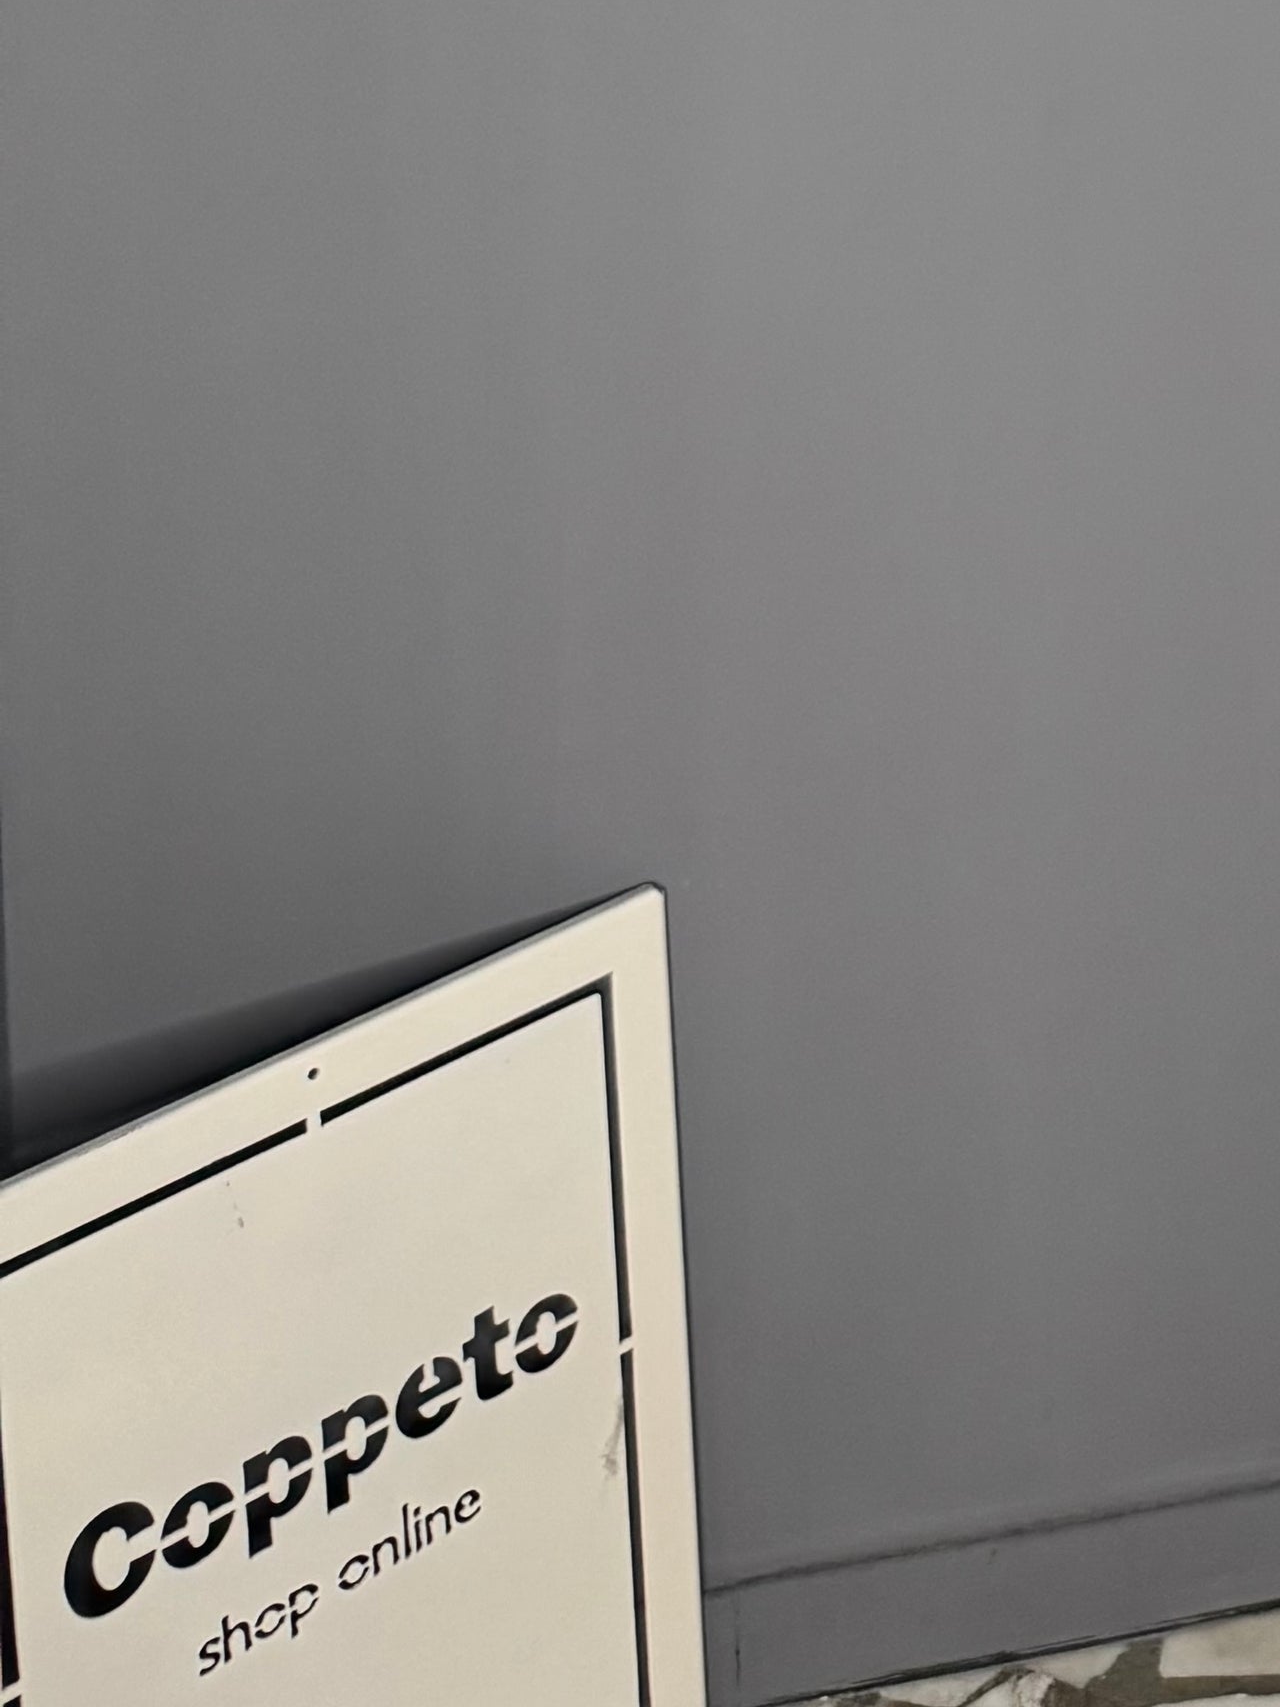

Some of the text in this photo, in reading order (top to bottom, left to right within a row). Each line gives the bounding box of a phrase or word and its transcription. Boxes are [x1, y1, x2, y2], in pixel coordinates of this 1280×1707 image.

[63, 1292, 579, 1619] Coppeto
[198, 1486, 482, 1676] shop online
